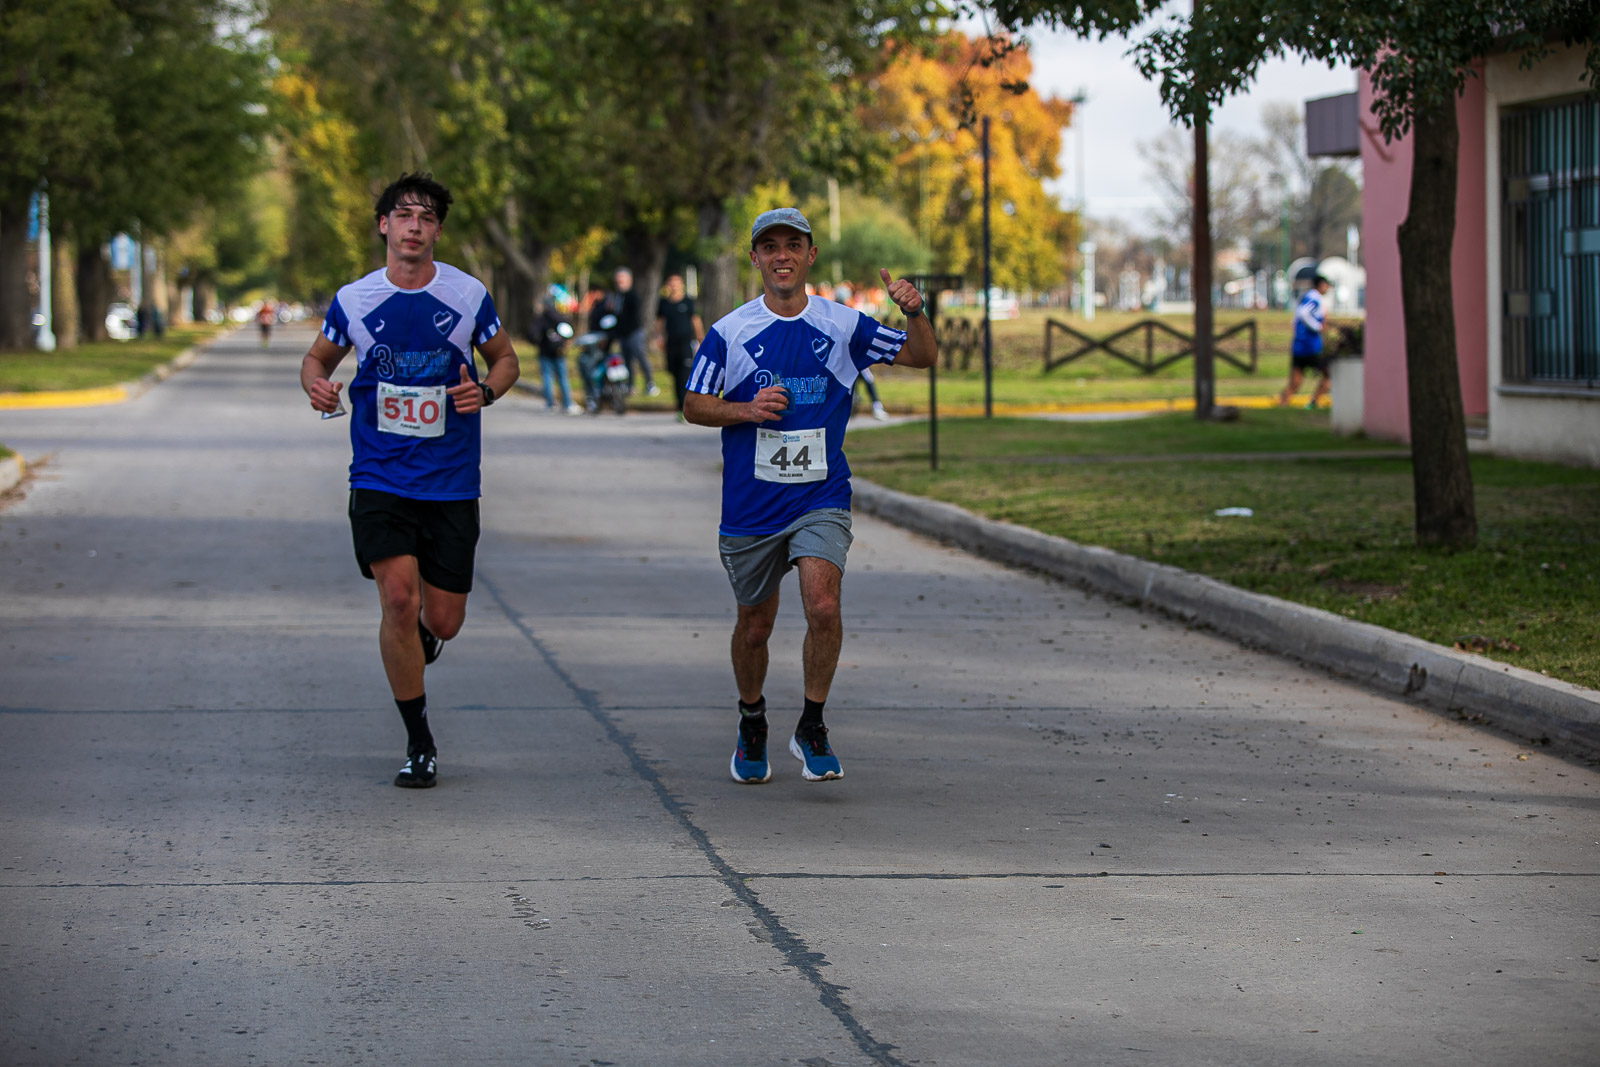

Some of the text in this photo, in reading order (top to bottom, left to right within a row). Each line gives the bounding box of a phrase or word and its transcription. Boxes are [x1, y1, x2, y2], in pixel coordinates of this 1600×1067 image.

[373, 344, 395, 379] 3
[394, 348, 451, 366] MARATÓN
[385, 397, 439, 424] 510
[769, 445, 812, 471] 44
